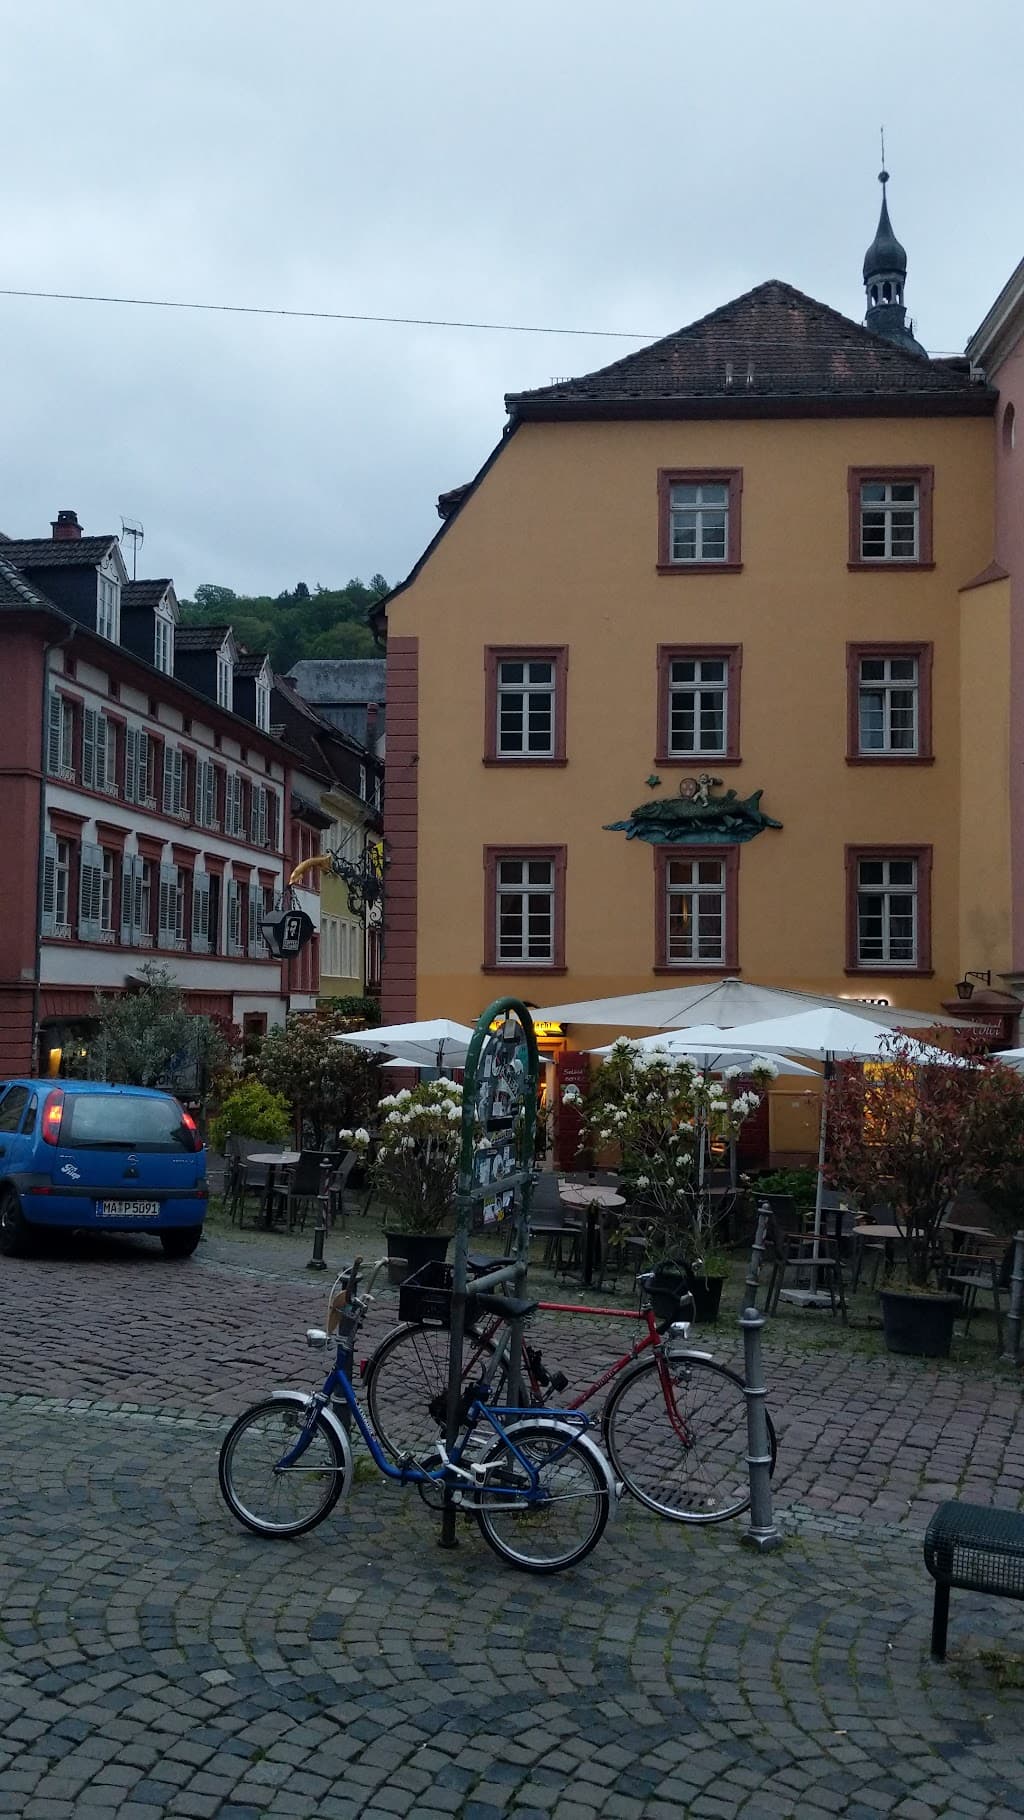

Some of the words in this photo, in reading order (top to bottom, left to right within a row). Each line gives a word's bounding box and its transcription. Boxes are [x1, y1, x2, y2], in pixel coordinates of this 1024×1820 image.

[103, 1202, 117, 1213] MA
[124, 1202, 131, 1213] P
[132, 1202, 158, 1214] 5091
